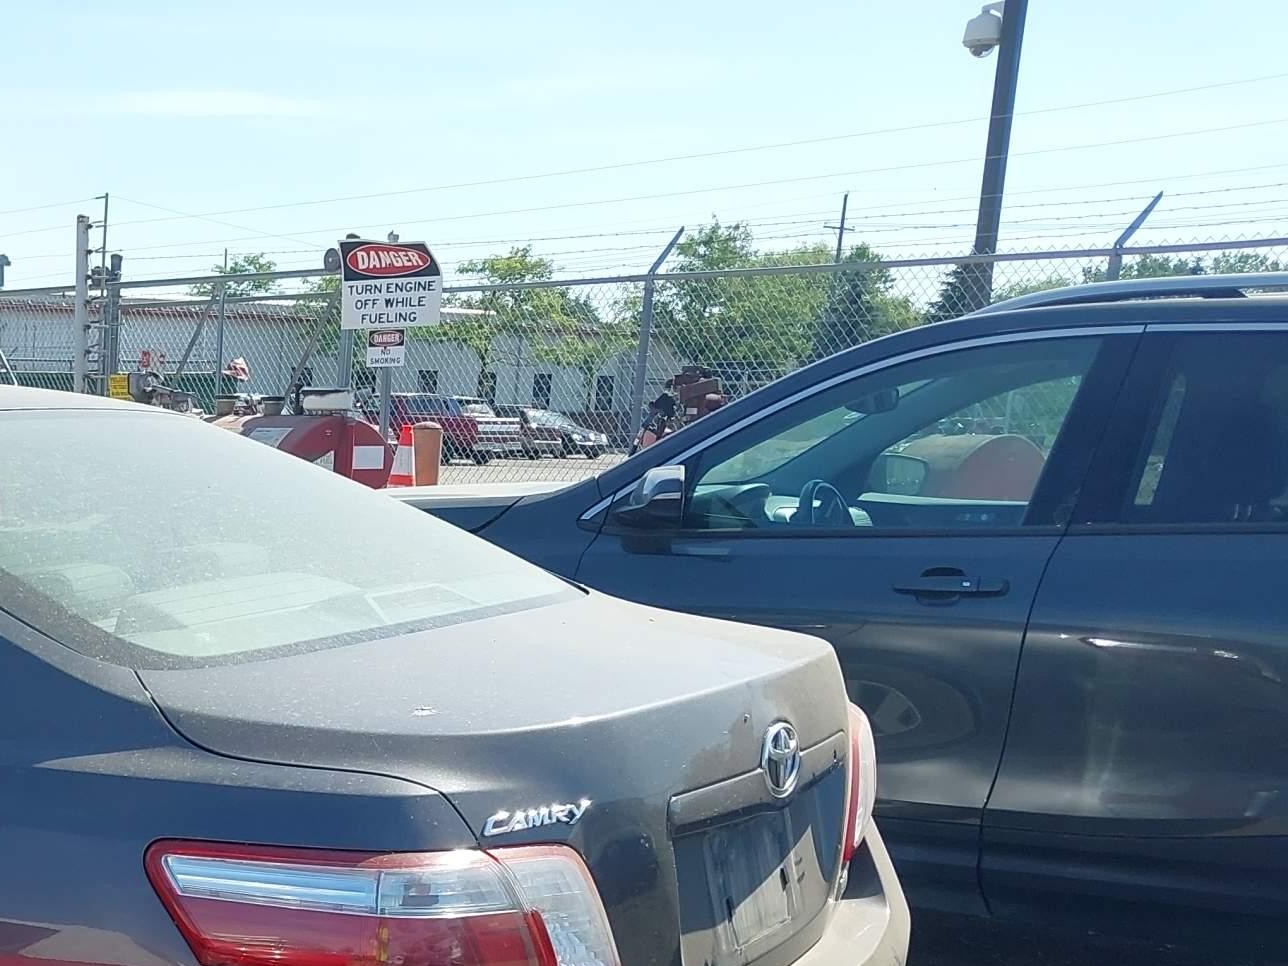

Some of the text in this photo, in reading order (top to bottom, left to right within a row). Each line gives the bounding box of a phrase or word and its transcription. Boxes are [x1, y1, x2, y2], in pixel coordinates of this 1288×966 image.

[356, 250, 424, 270] DANGER
[348, 280, 436, 296] TURN ENGINE
[355, 296, 427, 310] OFF WHILE
[361, 311, 417, 325] FUELING
[373, 333, 400, 343] DANGER
[370, 357, 401, 365] SMOKING
[483, 798, 592, 837] CAMRY
